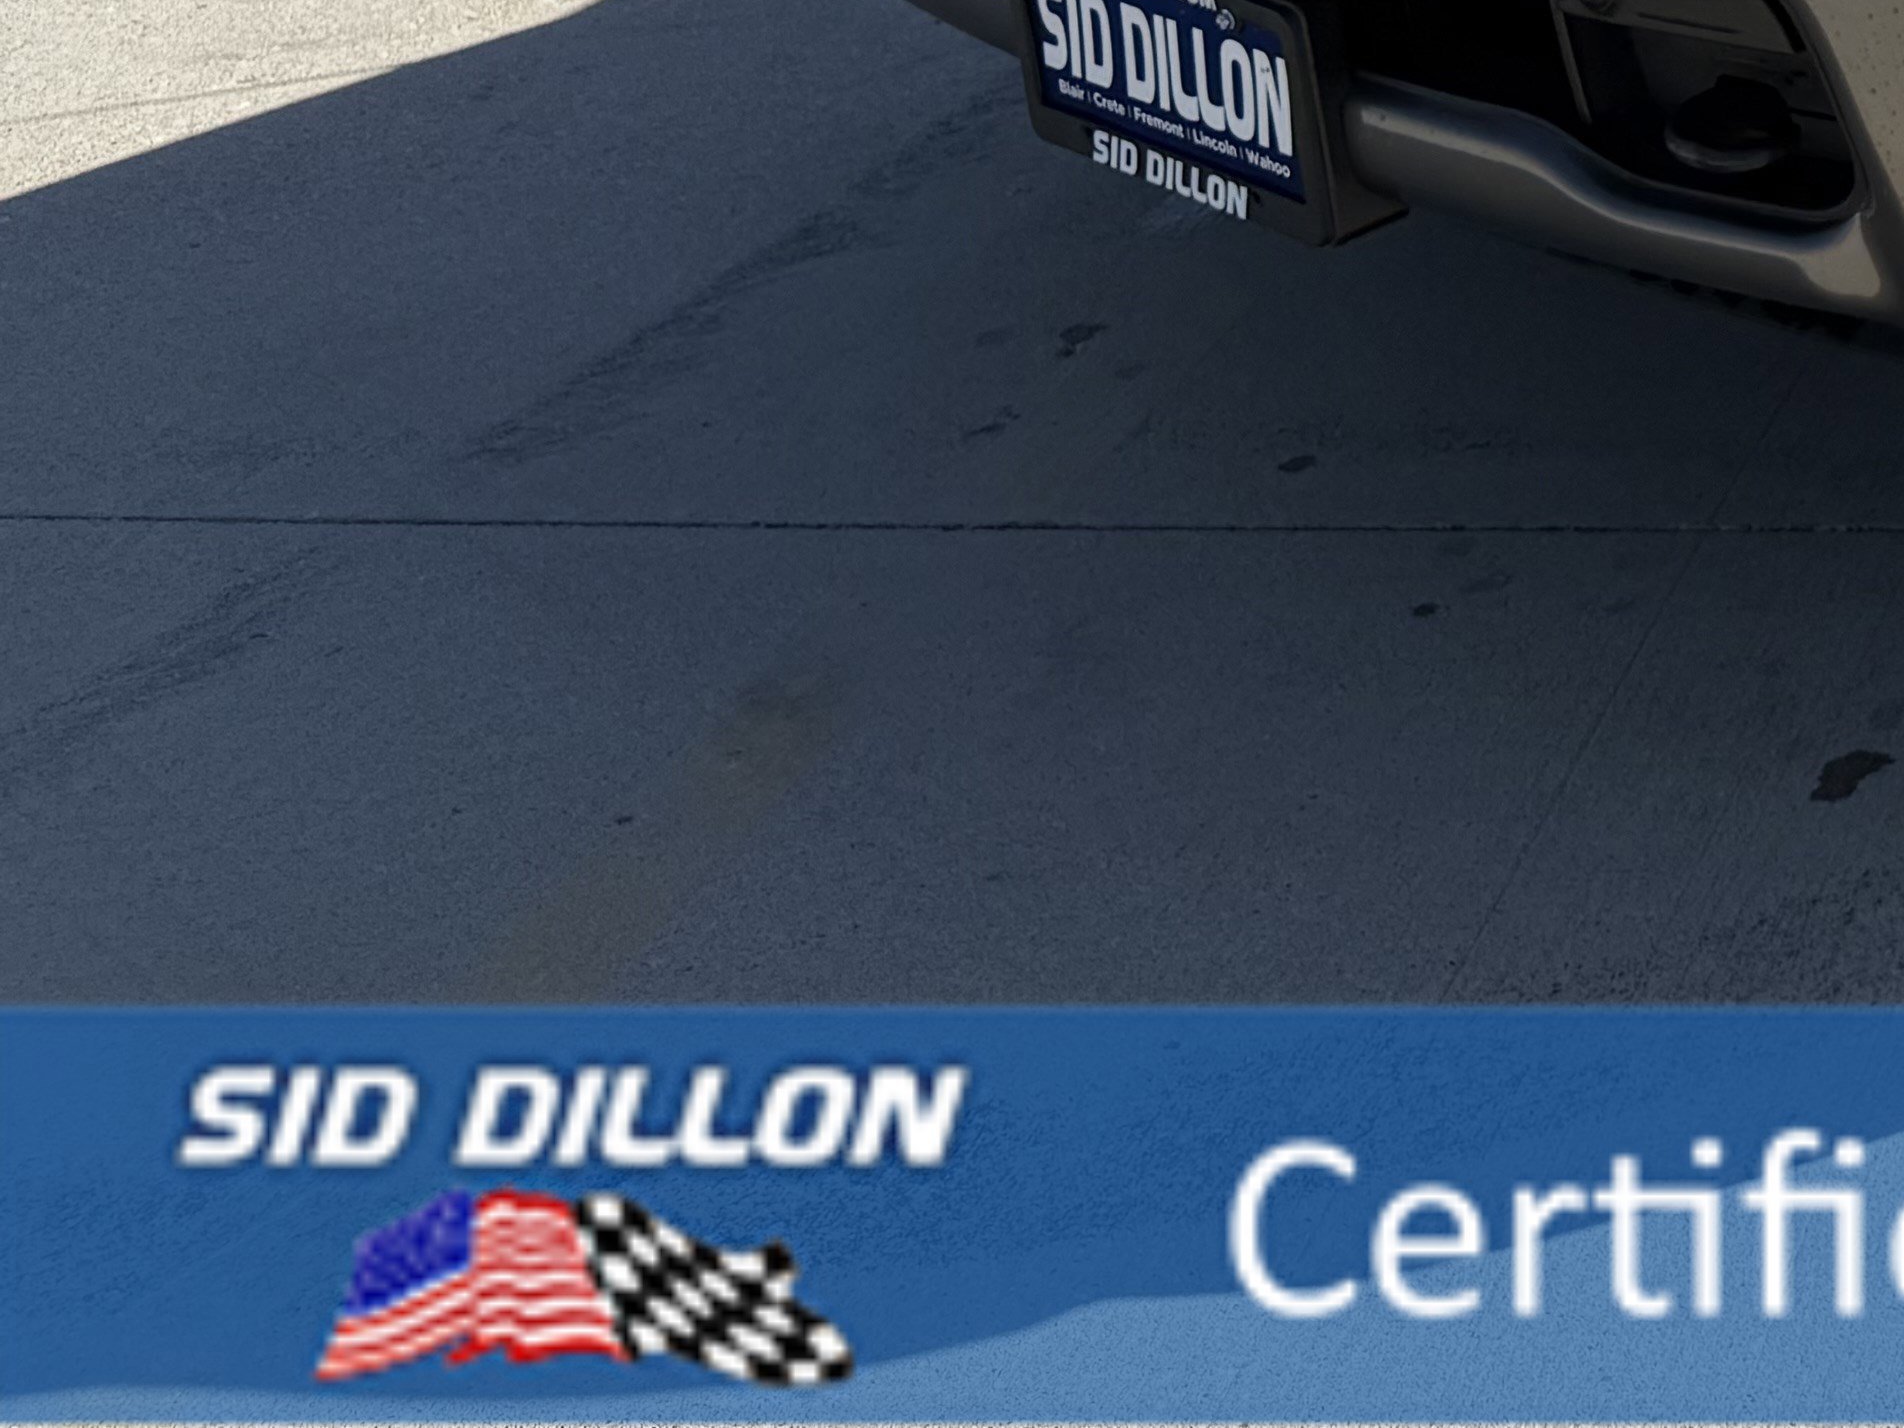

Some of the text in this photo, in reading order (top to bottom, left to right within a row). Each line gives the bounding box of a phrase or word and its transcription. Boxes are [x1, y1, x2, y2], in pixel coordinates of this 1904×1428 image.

[1058, 78, 1291, 179] Blair Crete Fremont Lincoln Wahoo
[1119, 1, 1293, 157] DILLON
[1092, 129, 1249, 220] SID DILLON
